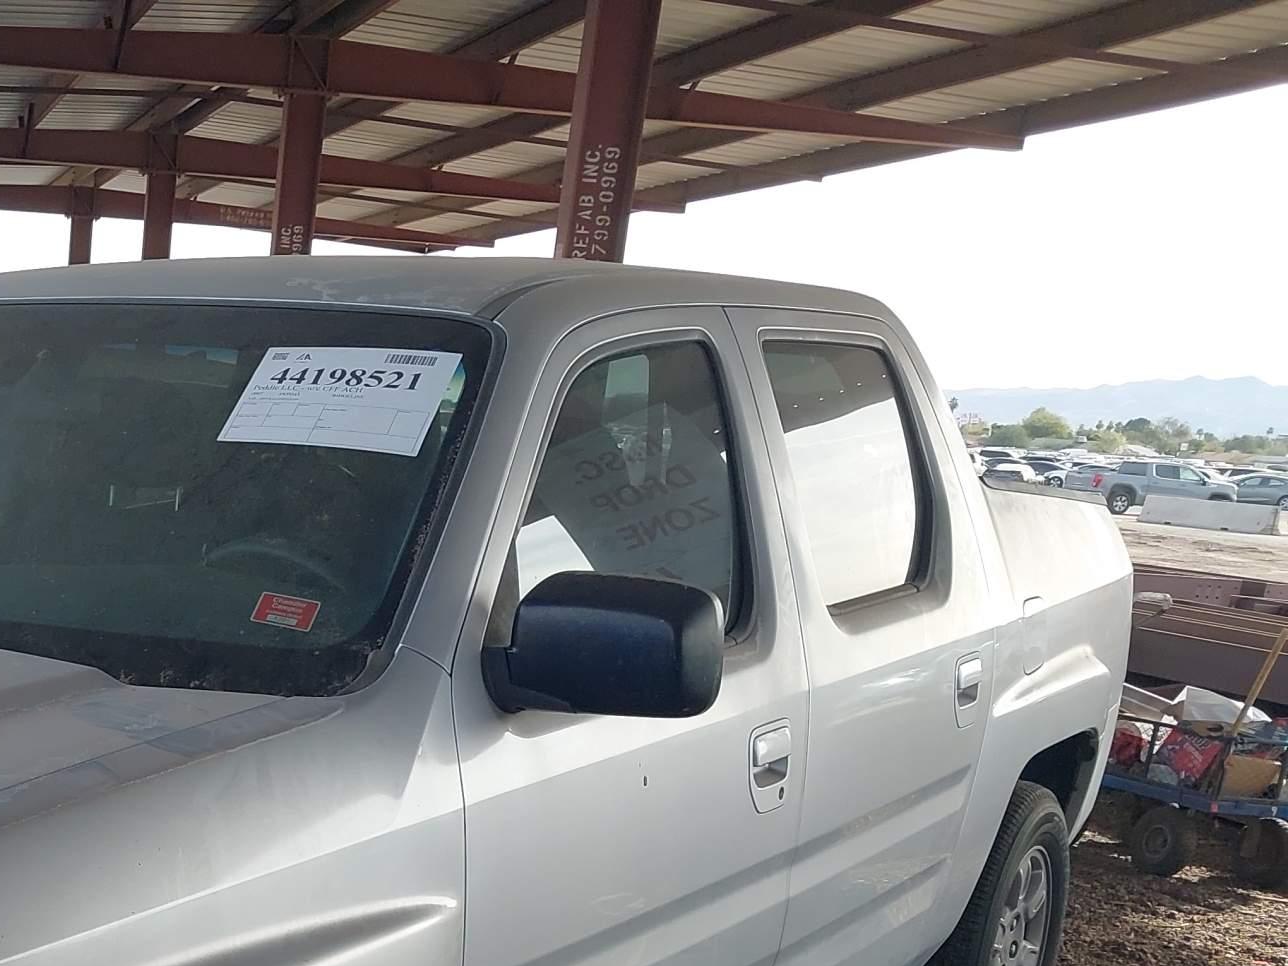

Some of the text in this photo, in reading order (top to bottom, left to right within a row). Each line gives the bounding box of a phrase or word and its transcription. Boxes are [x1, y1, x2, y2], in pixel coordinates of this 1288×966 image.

[581, 144, 603, 183] INC.
[591, 146, 621, 255] 799-0969
[280, 224, 293, 248] INC.
[292, 225, 304, 255] 969
[270, 367, 422, 391] 44198521
